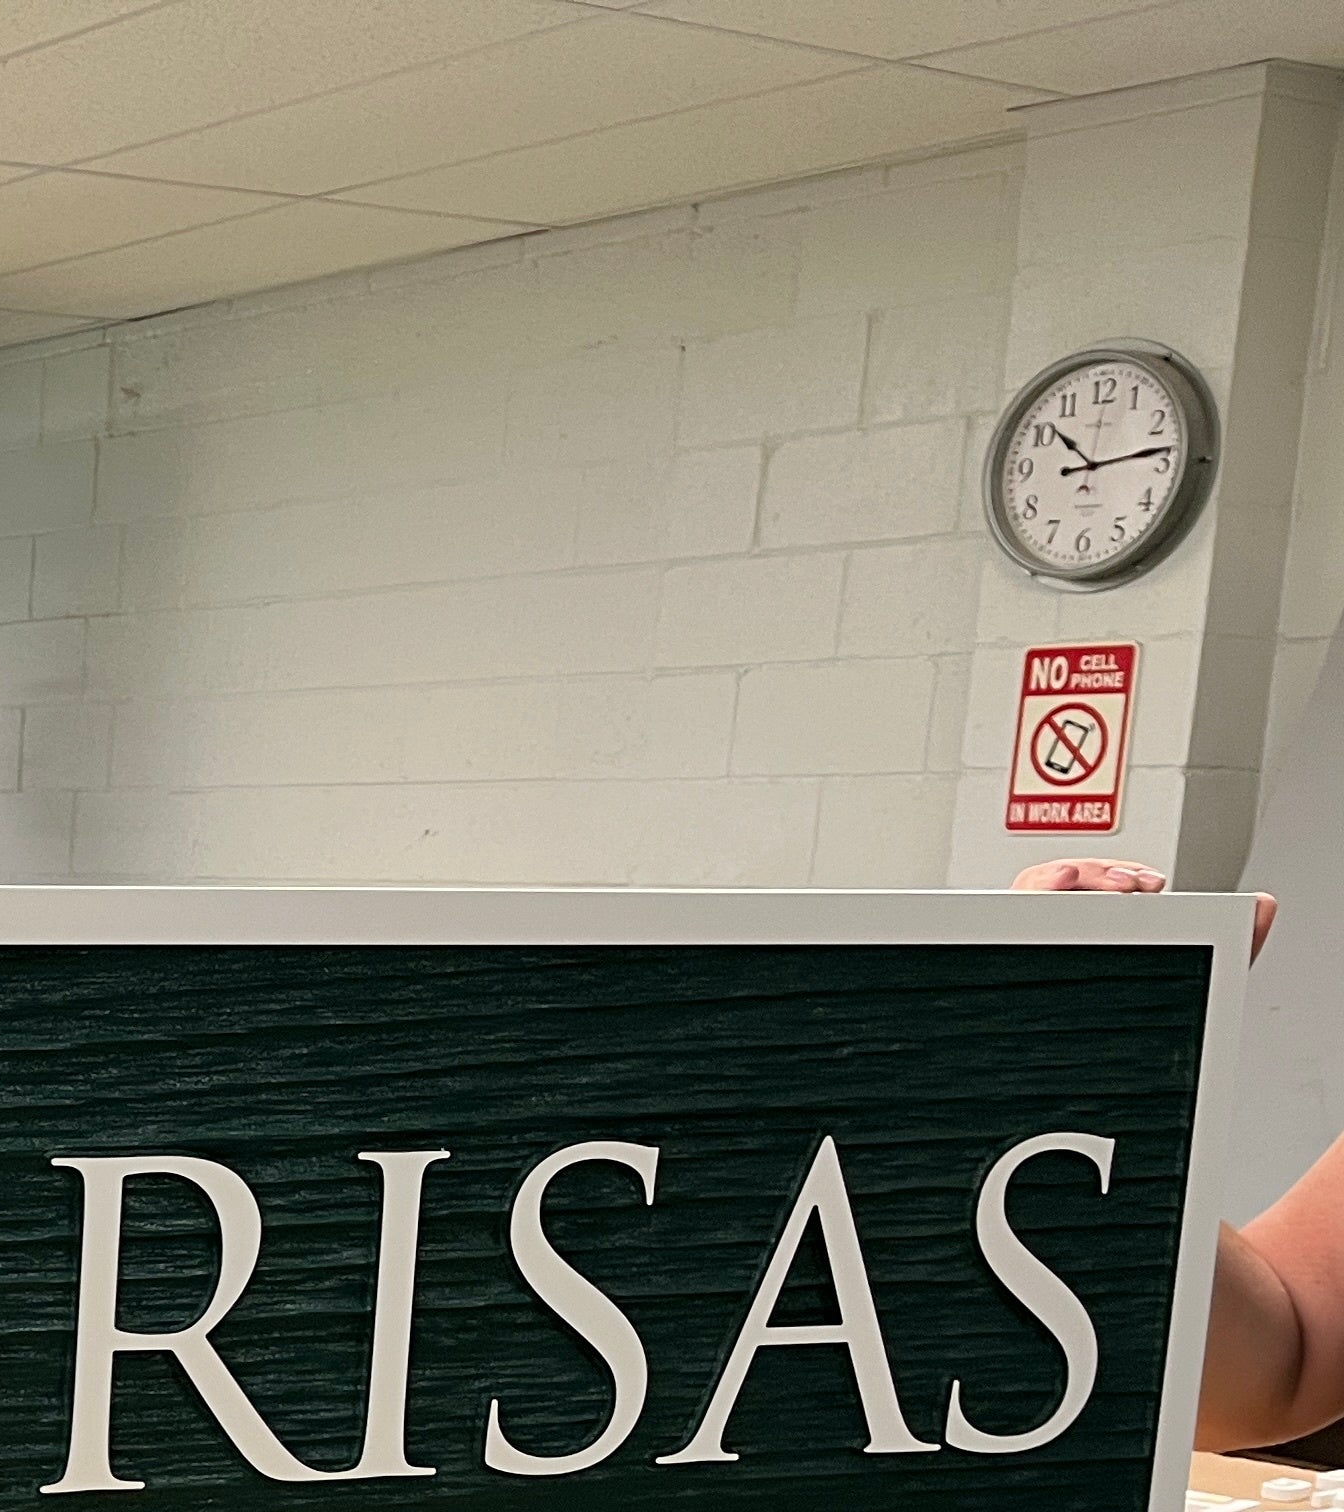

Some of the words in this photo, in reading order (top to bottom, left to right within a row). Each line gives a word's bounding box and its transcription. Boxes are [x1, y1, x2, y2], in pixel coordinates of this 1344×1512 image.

[1092, 378, 1118, 405] 12
[1129, 385, 1140, 411] 1
[1059, 392, 1078, 418] 11
[1032, 422, 1056, 448] 10
[1148, 409, 1166, 436] 2
[1017, 458, 1035, 484] 9
[1022, 494, 1039, 521] 8
[1137, 486, 1155, 512] 4
[1045, 519, 1062, 545] 7
[1075, 527, 1092, 553] 6
[1110, 516, 1128, 543] 5
[1030, 656, 1069, 691] NO
[1079, 654, 1119, 671] CELL
[1070, 671, 1125, 689] PHONE
[1010, 802, 1025, 823] IN
[1029, 802, 1069, 823] WORK
[1071, 801, 1111, 823] AREA
